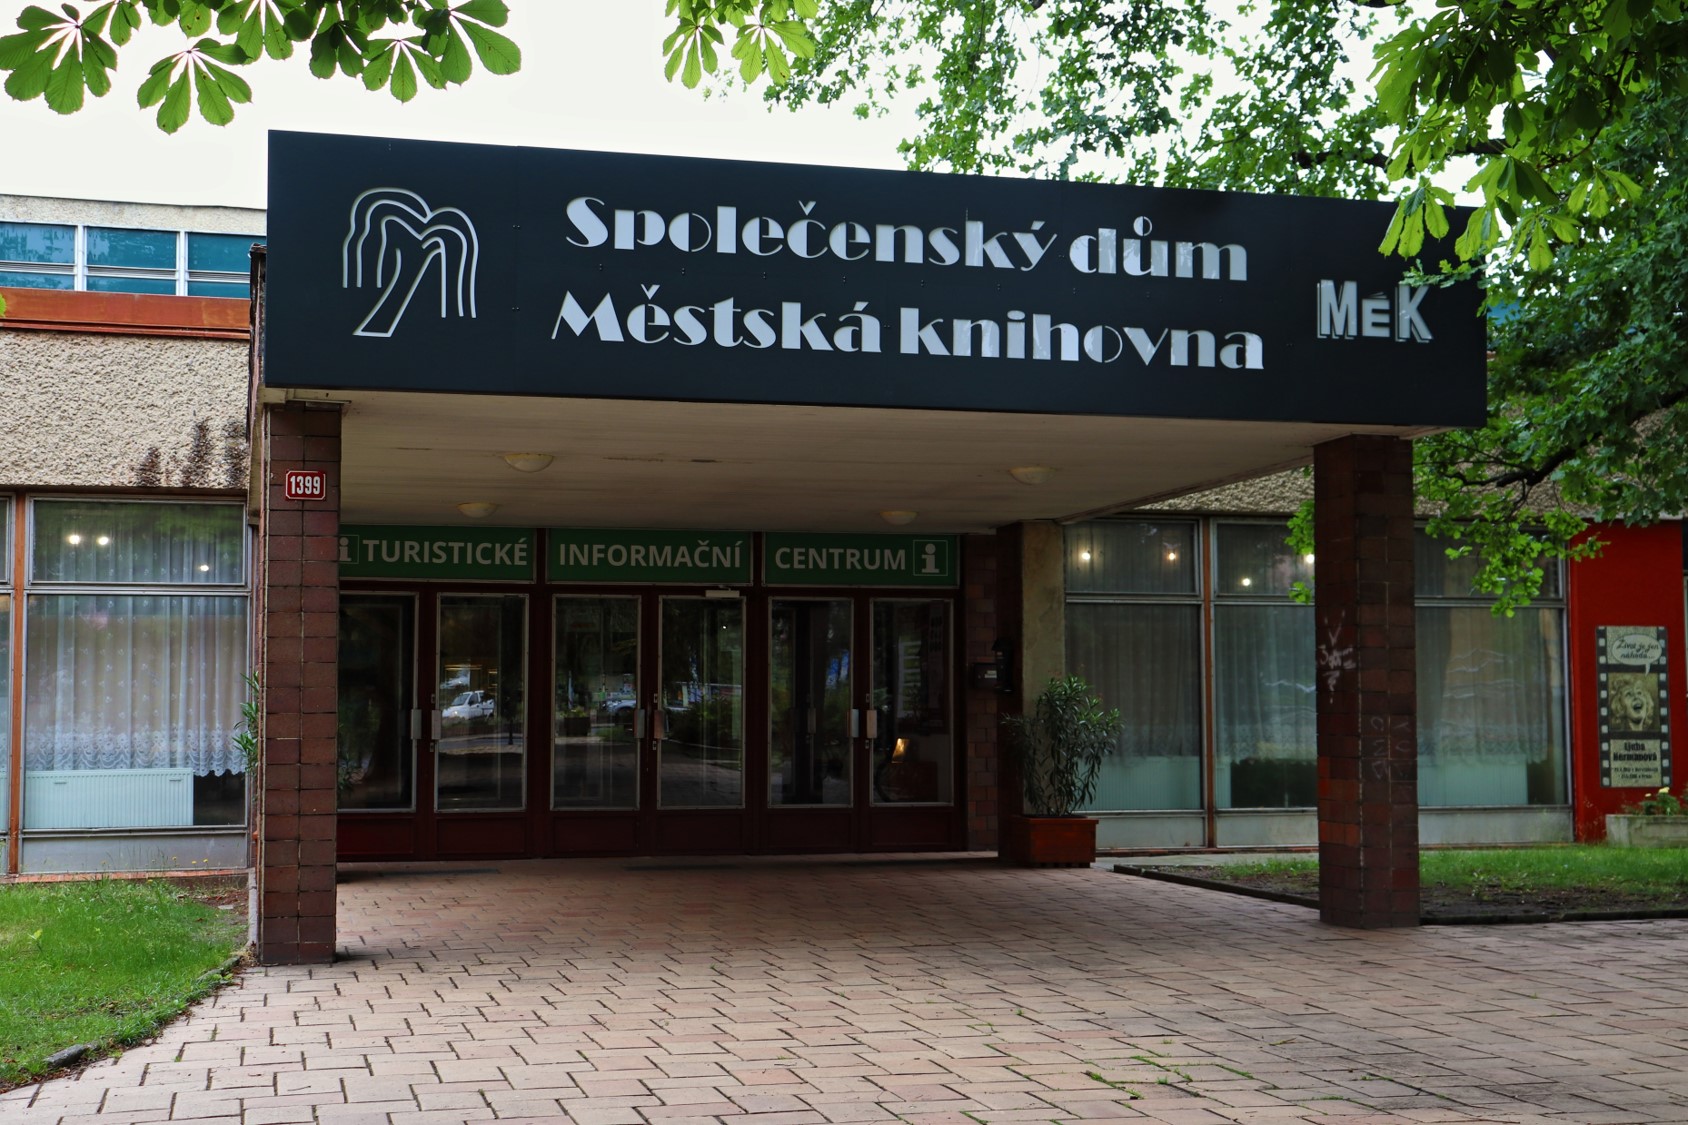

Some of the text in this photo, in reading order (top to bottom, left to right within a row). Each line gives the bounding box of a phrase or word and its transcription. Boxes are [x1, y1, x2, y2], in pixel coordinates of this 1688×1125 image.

[565, 196, 1248, 281] Společenský dům
[551, 284, 1264, 370] Městská knihovna
[290, 476, 321, 495] 1399
[363, 538, 528, 567] TURISTICKÉ
[559, 540, 743, 568] INFORMAČNÍ
[775, 547, 906, 570] CENTRUM
